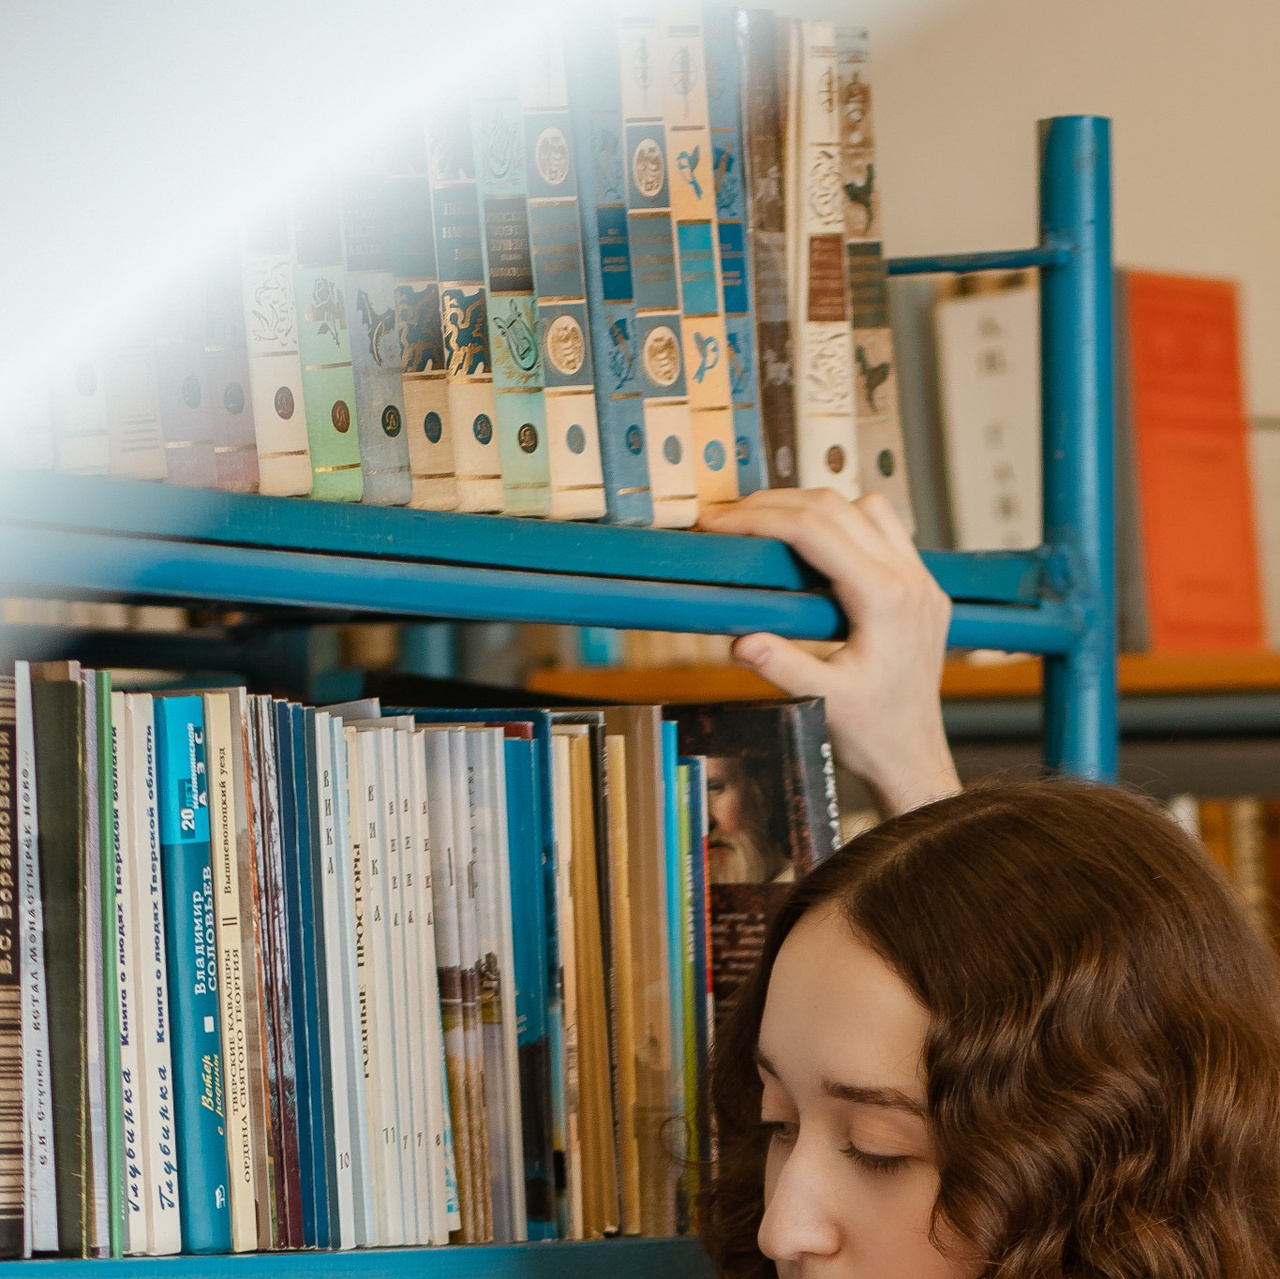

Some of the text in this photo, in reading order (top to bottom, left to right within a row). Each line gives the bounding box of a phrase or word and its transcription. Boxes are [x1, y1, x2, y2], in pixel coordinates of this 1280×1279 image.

[180, 809, 195, 831] 20
[218, 748, 232, 894] Вышневолоцкий уезд
[115, 903, 126, 965] людях
[145, 724, 177, 1210] Глубинка Книга о людях Тверской области
[191, 891, 207, 995] Владимир
[202, 866, 217, 992] СОЛОВЬЕВ
[118, 990, 129, 1046] Книга
[120, 971, 127, 982] о
[225, 948, 239, 1115] ТВЕРСКИЕ КАВАЛЕРЫ
[233, 948, 251, 1183] ОРДЕНА СВЯТОГО ГЕОРГИЯ
[201, 1055, 214, 1111] Ветер
[212, 1054, 225, 1117] родины
